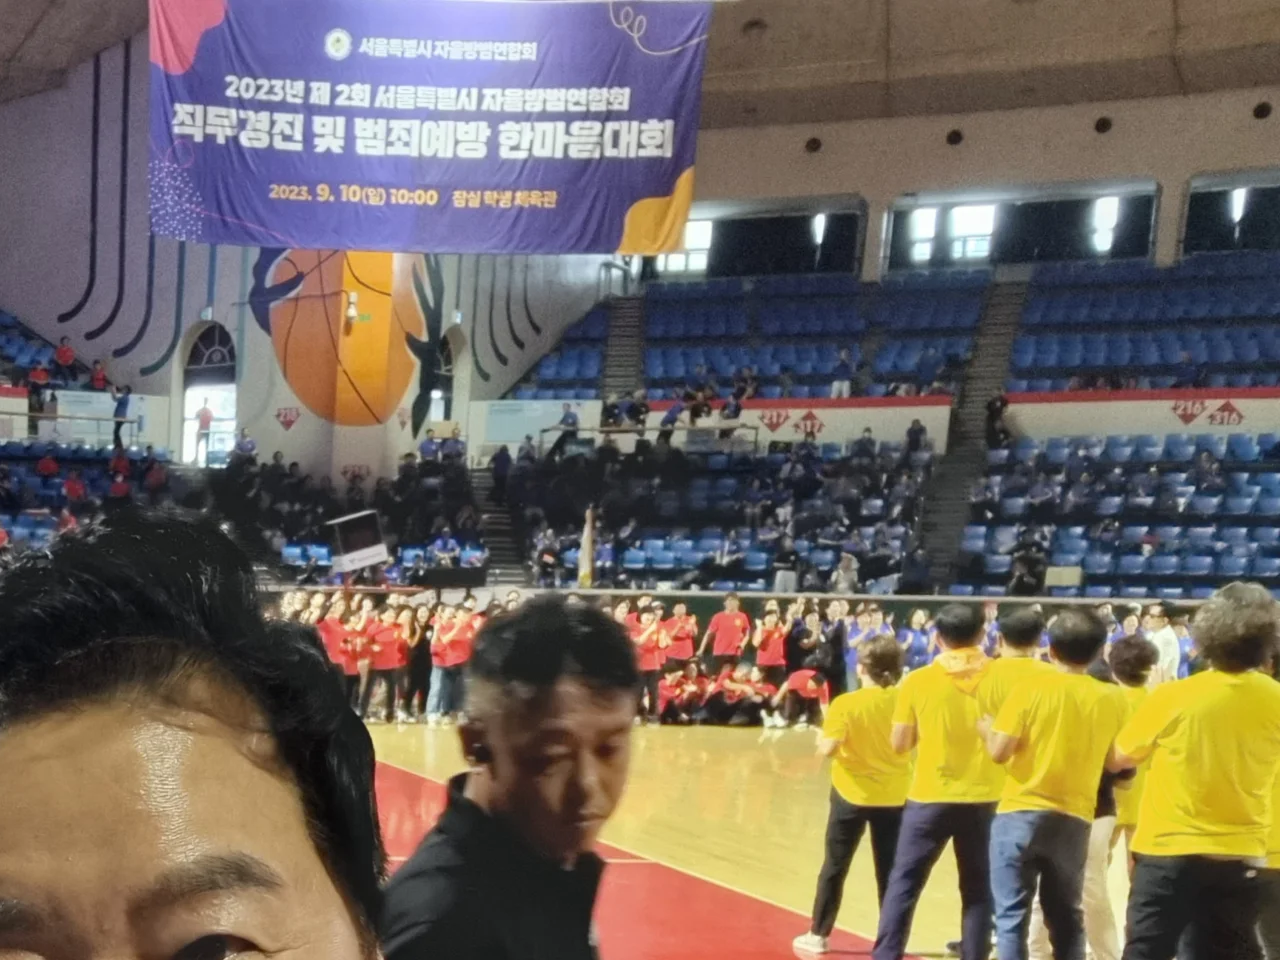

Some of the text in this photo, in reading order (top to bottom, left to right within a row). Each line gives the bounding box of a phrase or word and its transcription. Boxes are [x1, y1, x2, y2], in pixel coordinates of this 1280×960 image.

[359, 37, 433, 59] 서울특별시
[225, 75, 631, 112] 2023년 제 2회 서울특별시 자율방범연합회
[171, 102, 675, 160] 직무경진 및 범죄예방 한마음대회
[268, 183, 312, 201] 2023.
[315, 183, 335, 202] 9.
[339, 184, 387, 207] 10(일)
[390, 188, 439, 206] 10:00
[451, 189, 481, 209] 잠실
[514, 190, 558, 209] 체육관
